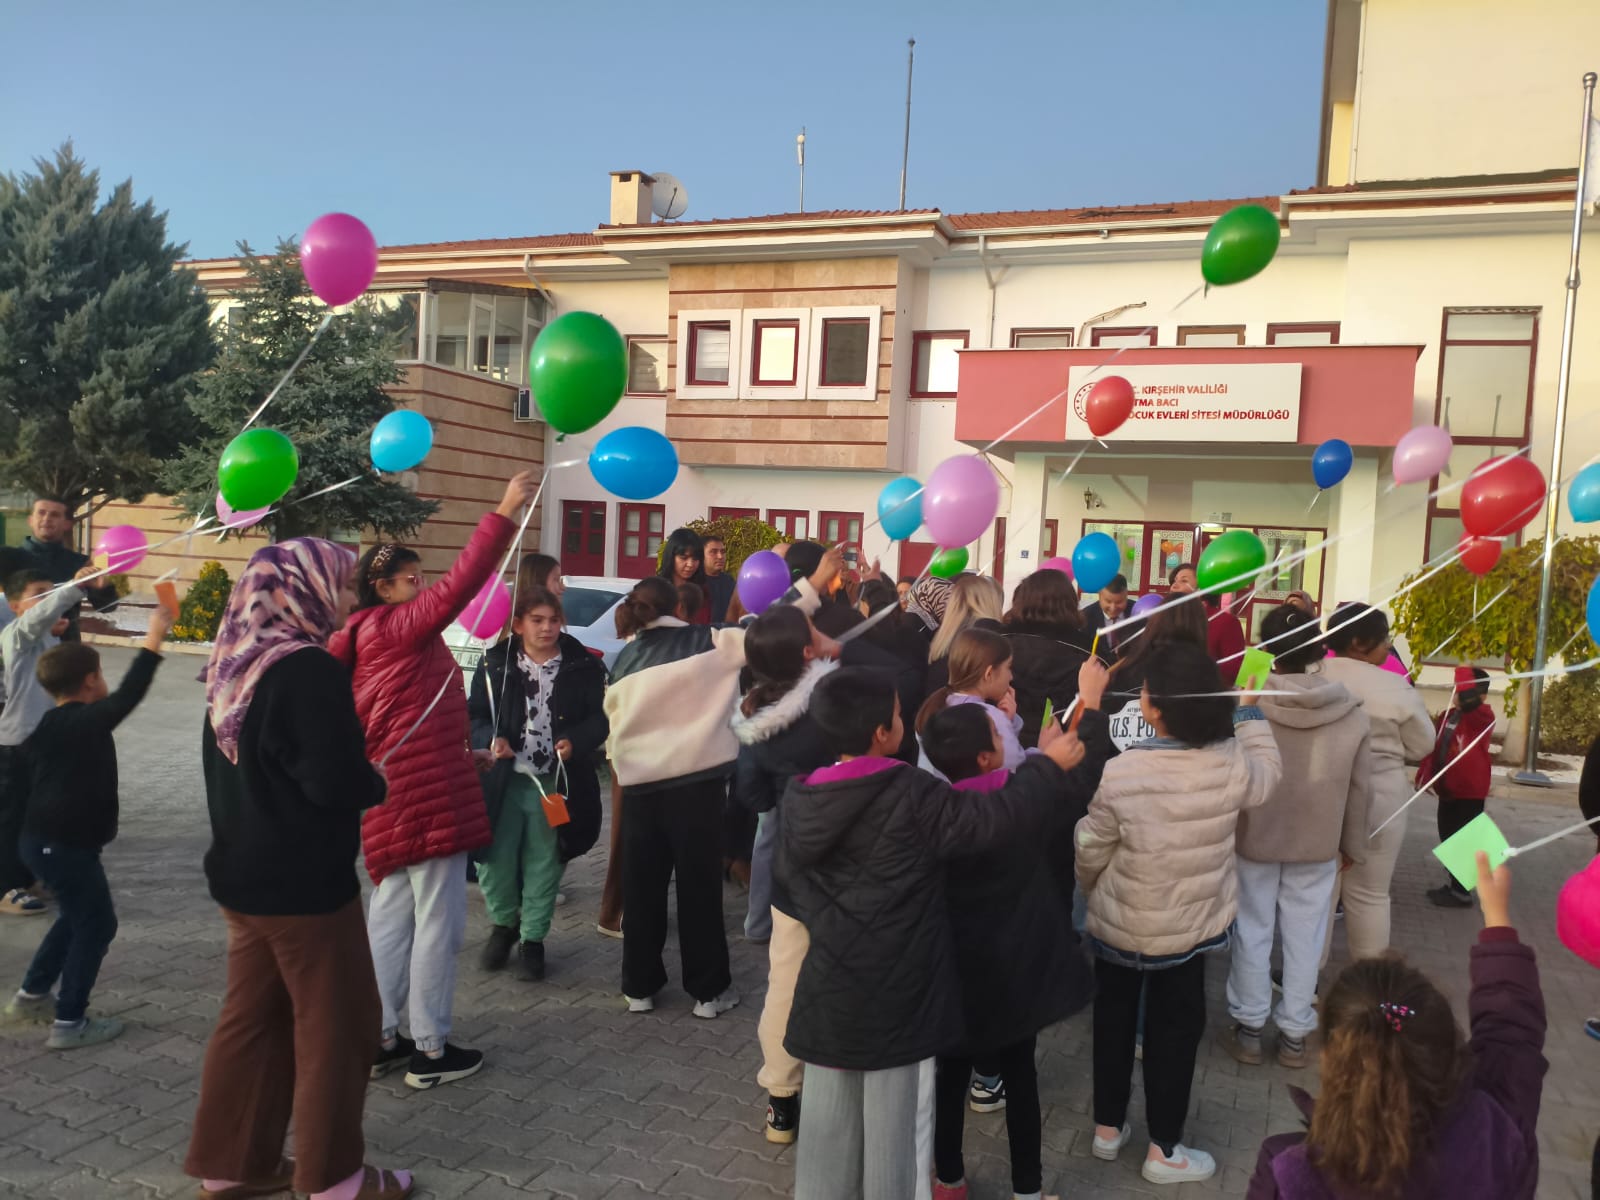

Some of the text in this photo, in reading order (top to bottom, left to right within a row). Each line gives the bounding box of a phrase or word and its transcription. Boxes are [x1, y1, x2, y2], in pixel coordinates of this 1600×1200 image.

[1142, 384, 1185, 396] KIRŞEHİR
[1187, 384, 1228, 394] VALİLİĞİ
[1133, 398, 1179, 407] TMA BACI
[1128, 409, 1290, 420] OCUK EVLERİ SİTESİ MÜDÜRLÜĞÜ
[1112, 716, 1154, 738] U.S. PO
